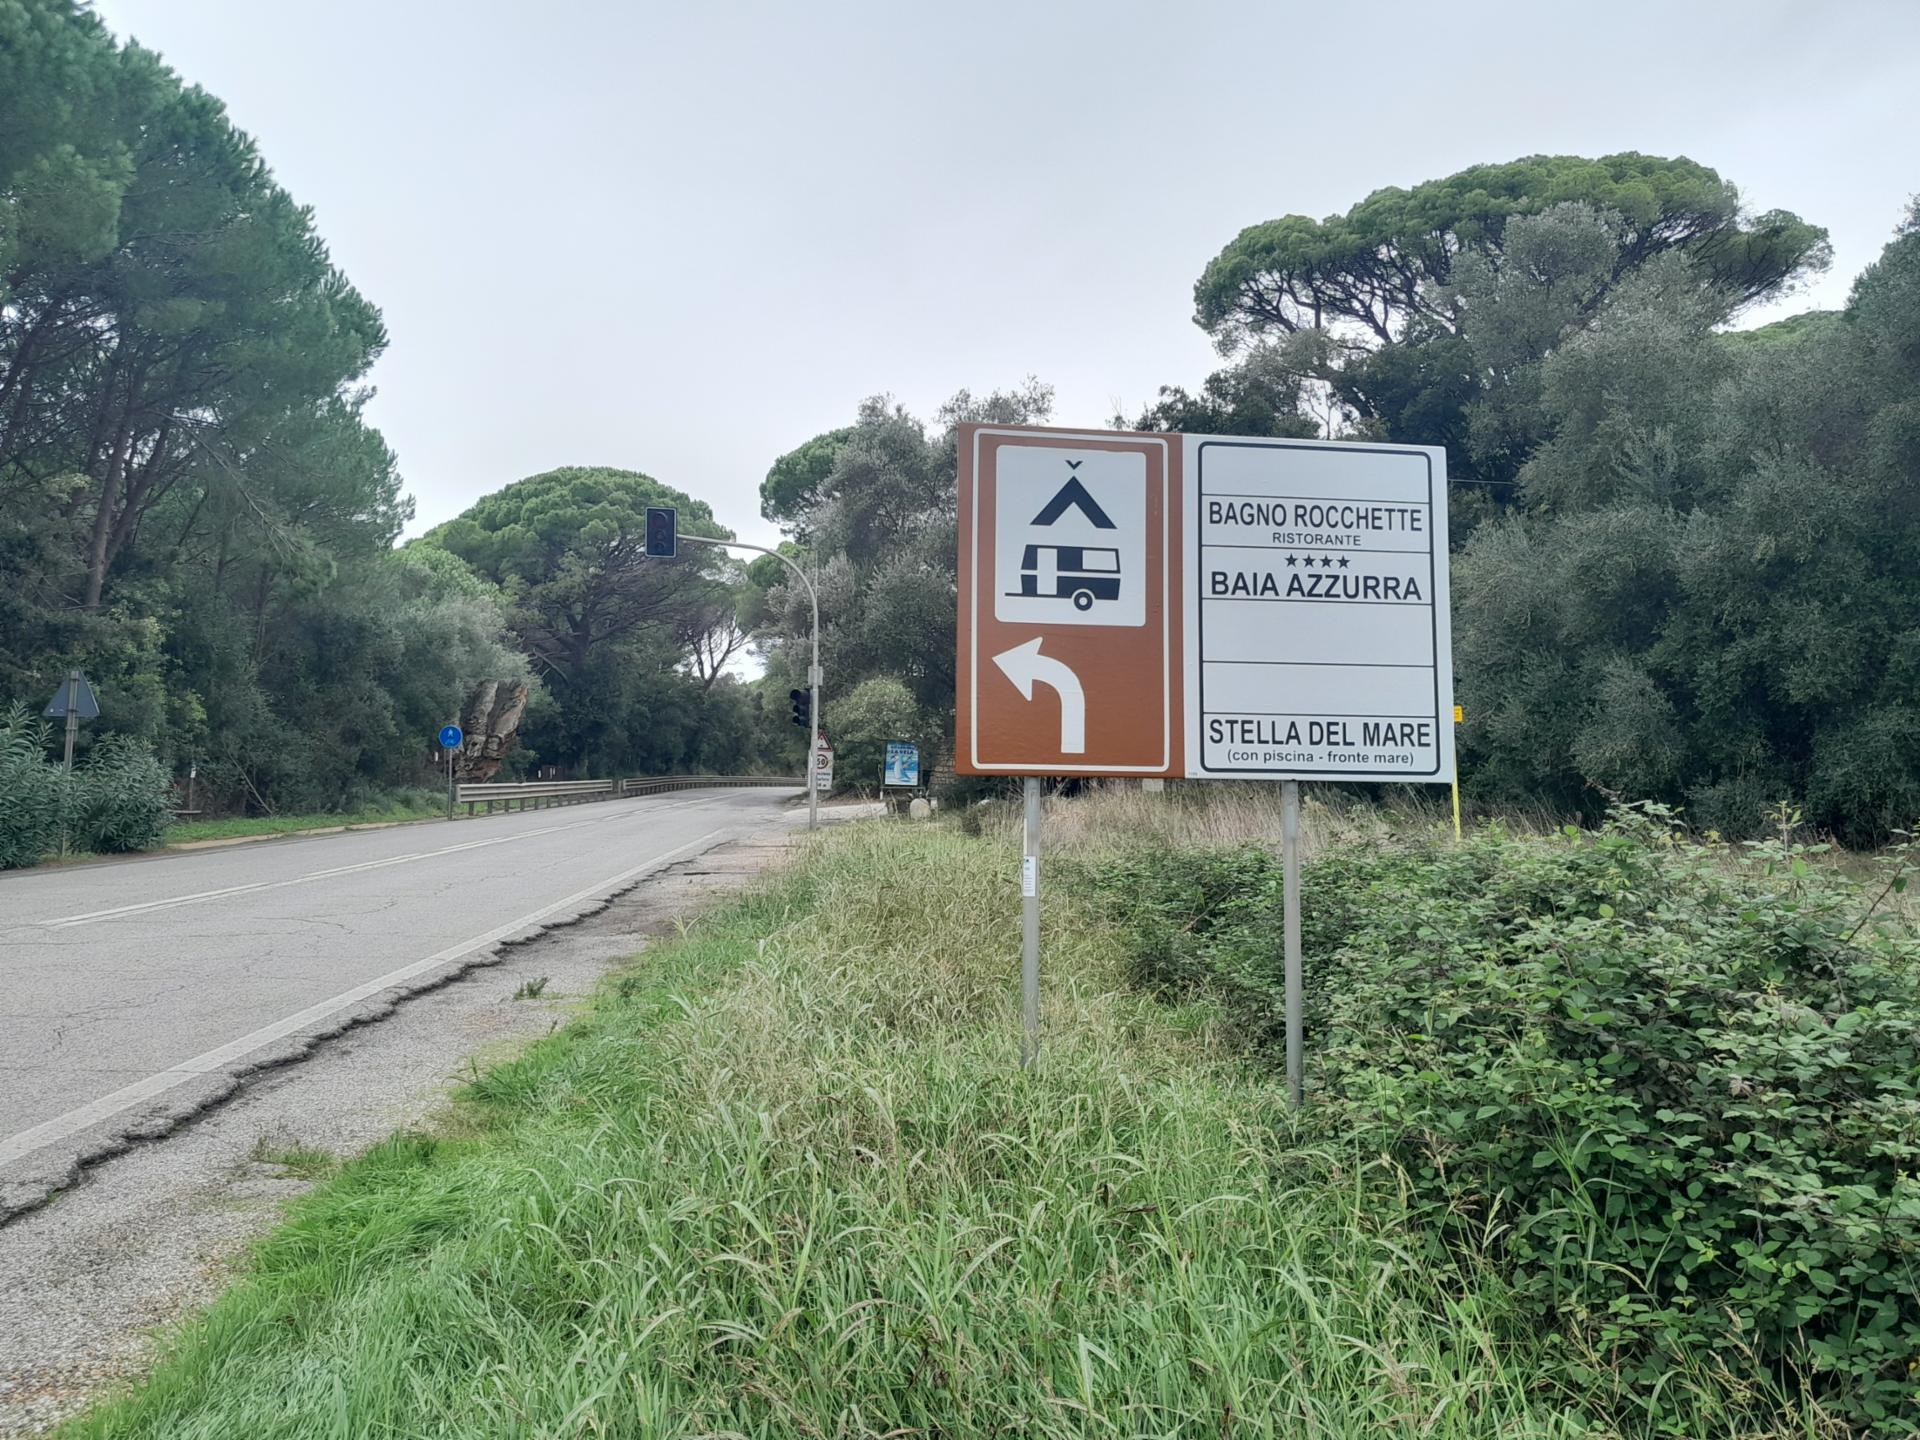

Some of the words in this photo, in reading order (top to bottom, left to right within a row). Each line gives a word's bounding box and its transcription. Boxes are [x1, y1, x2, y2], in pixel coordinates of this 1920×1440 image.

[1208, 501, 1287, 527] BAGNO
[1294, 504, 1423, 531] ROCCHETTE
[1272, 532, 1361, 546] RISTORANTE
[1211, 571, 1280, 597] BAIA
[1285, 573, 1423, 600] AZZURRA
[1209, 718, 1302, 746] STELLA
[1308, 720, 1356, 747] DEL
[1362, 722, 1432, 748] MARE
[1227, 749, 1259, 763] (con
[1263, 750, 1314, 764] piscina
[1327, 750, 1370, 764] fronte
[1374, 752, 1414, 767] mare)
